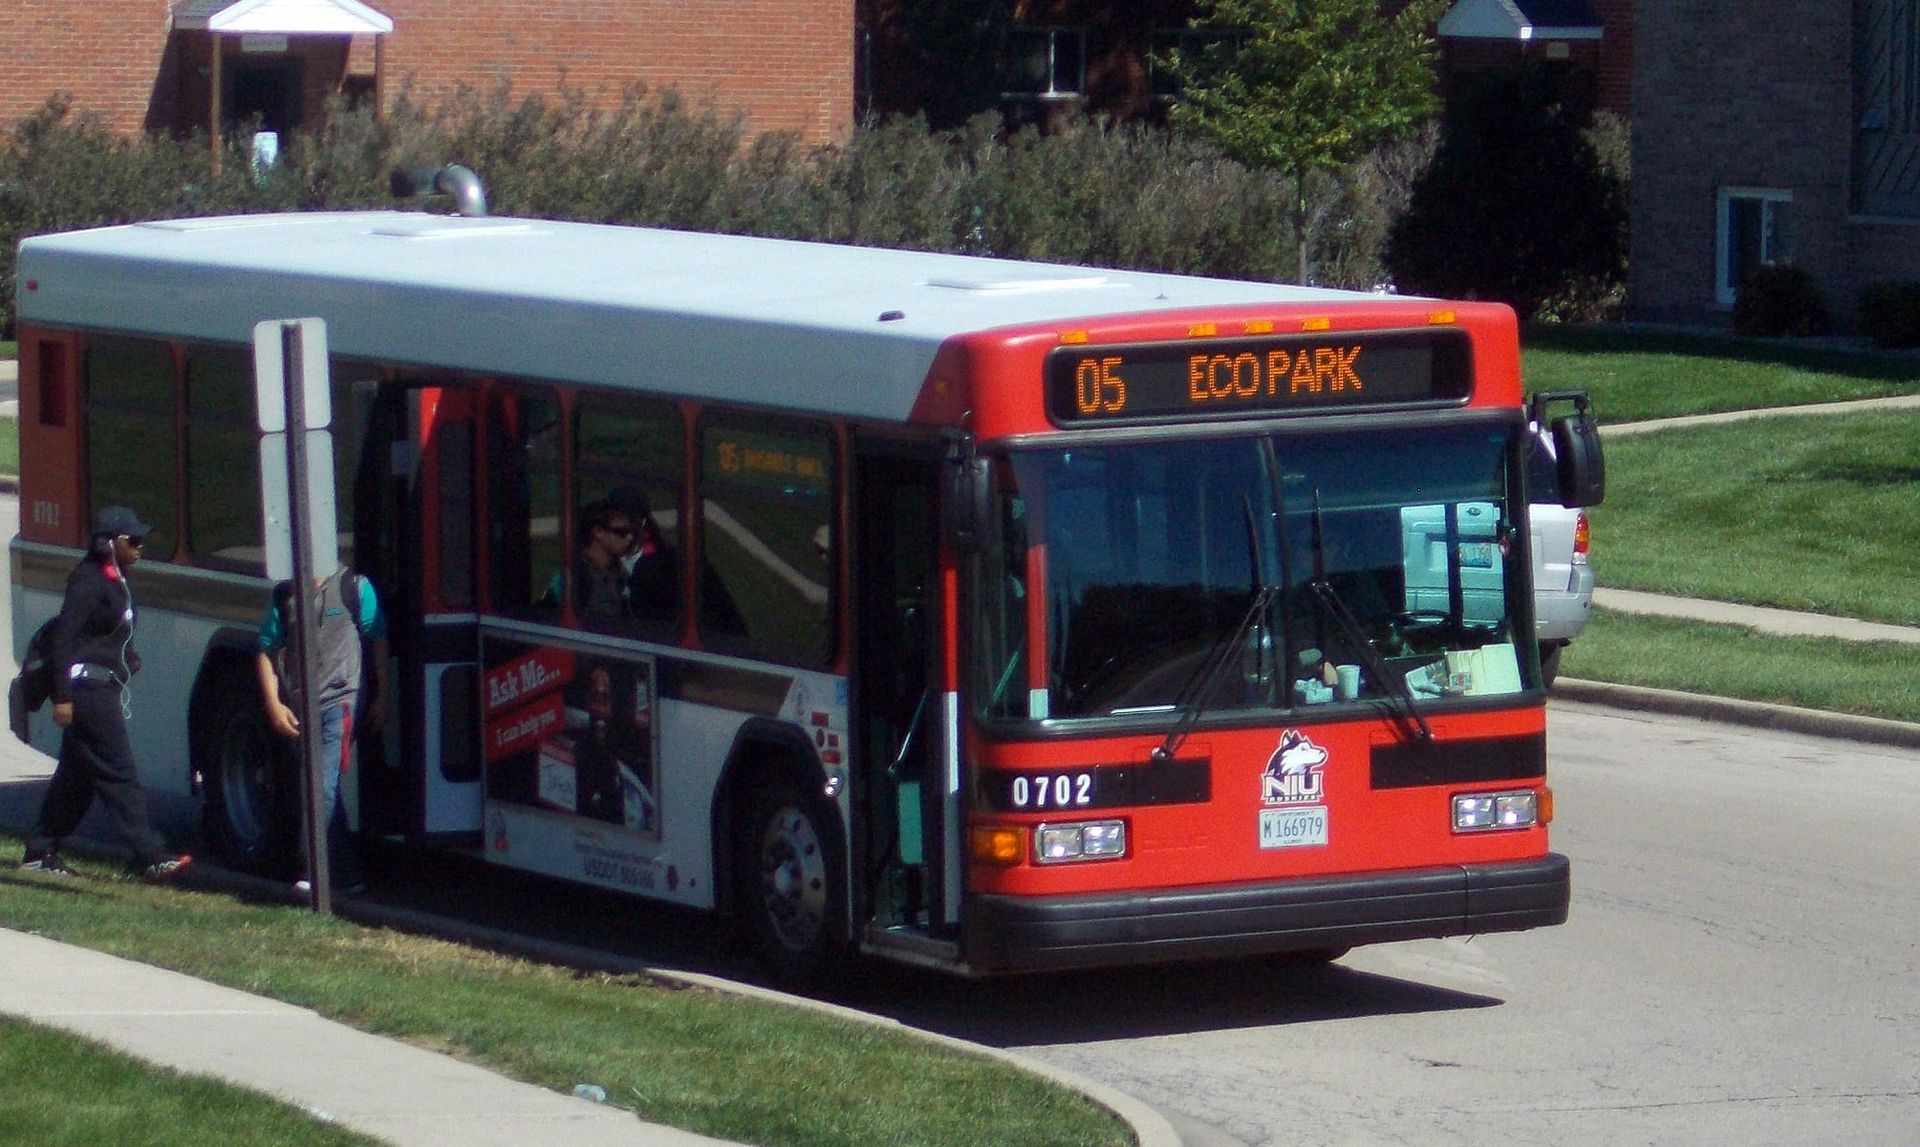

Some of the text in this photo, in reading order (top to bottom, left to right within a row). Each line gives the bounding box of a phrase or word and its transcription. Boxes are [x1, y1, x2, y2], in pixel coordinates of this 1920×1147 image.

[1076, 346, 1363, 413] 05 ECO PARK
[489, 671, 519, 708] Ask
[1013, 773, 1091, 805] 0702
[1264, 774, 1320, 797] NIU
[1263, 816, 1323, 839] M 166979
